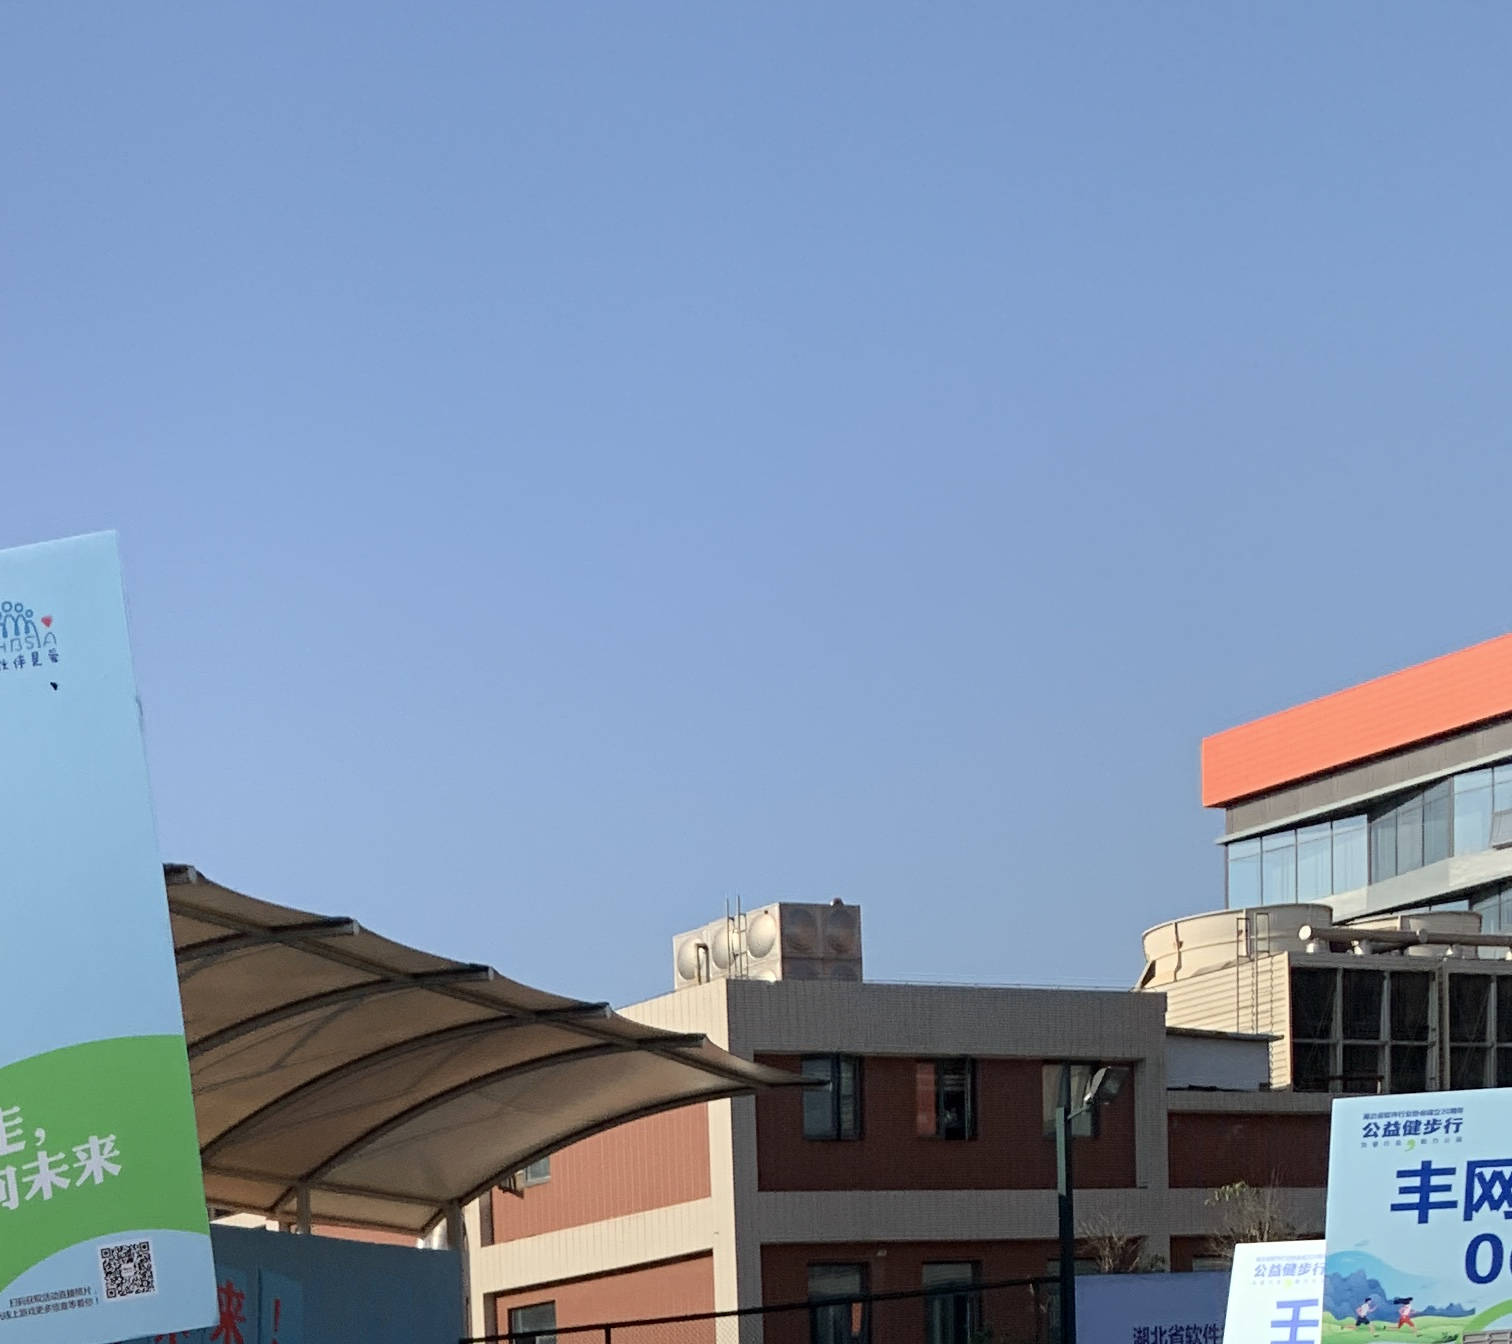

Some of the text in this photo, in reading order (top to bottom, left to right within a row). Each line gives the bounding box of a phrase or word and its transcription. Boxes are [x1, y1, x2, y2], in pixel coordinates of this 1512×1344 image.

[1361, 1117, 1465, 1139] 公益健步行
[1465, 1232, 1512, 1285] 0
